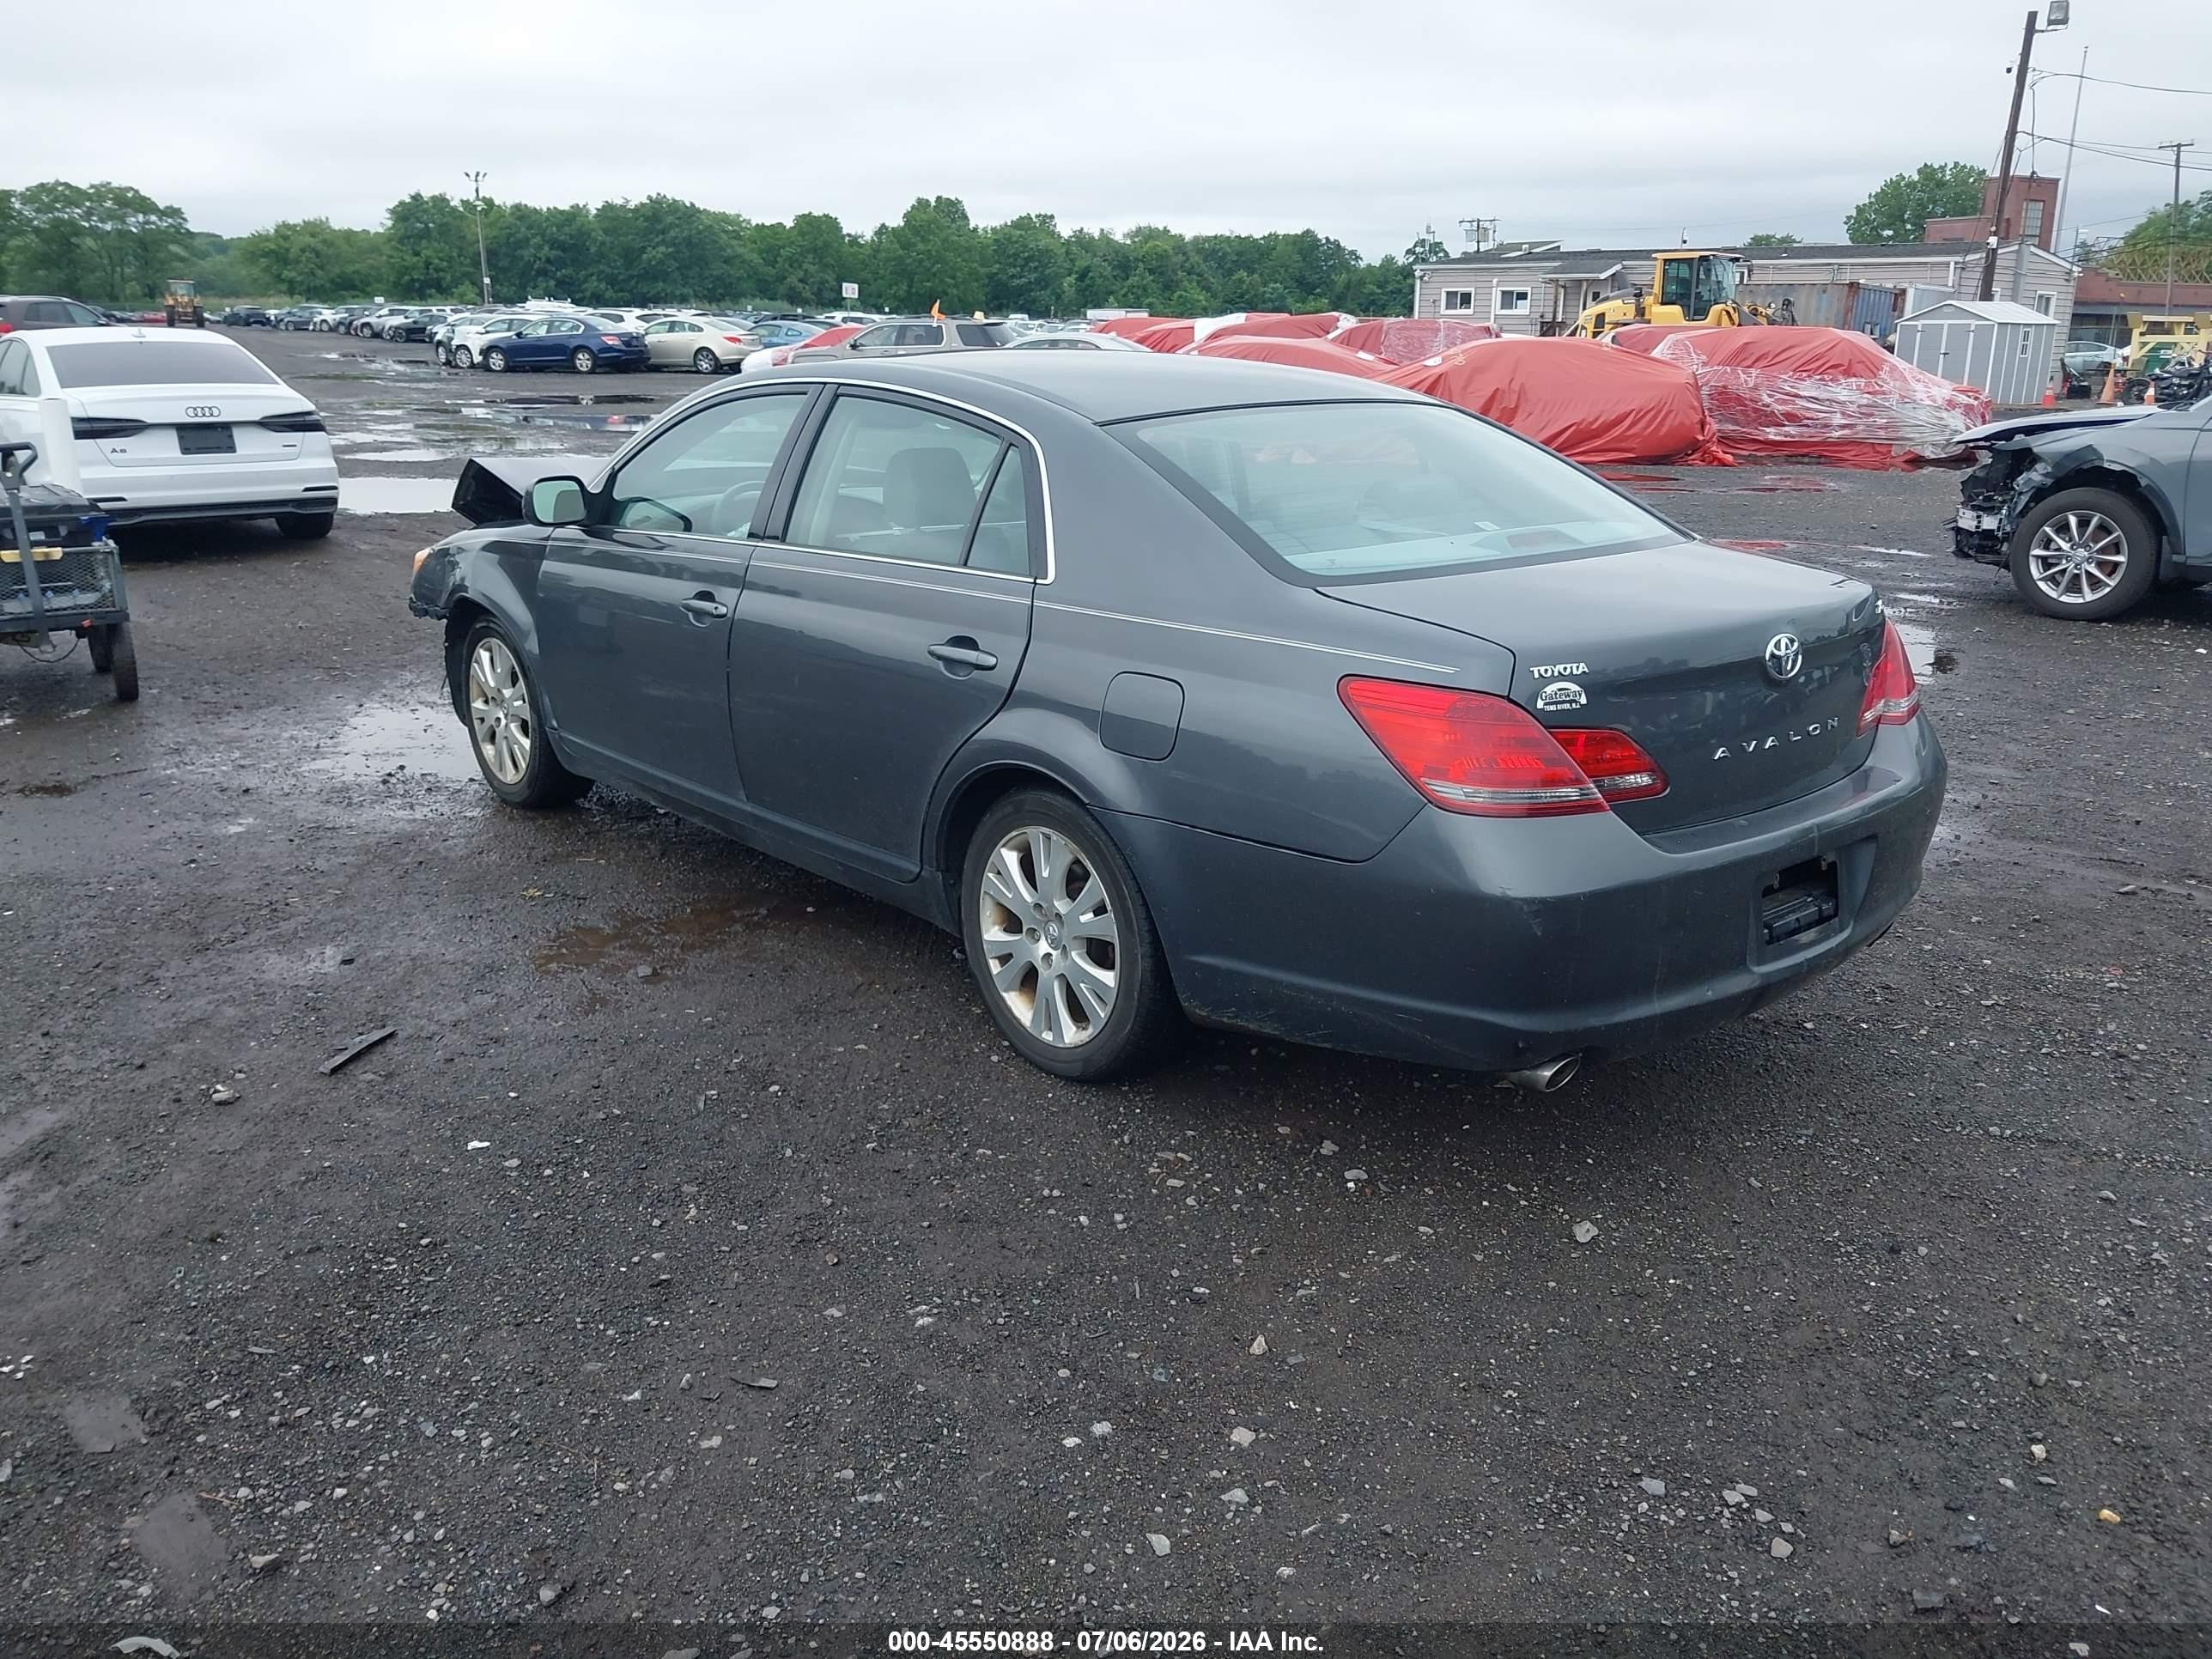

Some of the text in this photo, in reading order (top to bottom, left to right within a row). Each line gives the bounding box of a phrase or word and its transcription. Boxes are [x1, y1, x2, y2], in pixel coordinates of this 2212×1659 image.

[1529, 662, 1589, 679] TOYOTA
[1540, 690, 1583, 702] Gateway
[1712, 717, 1839, 761] AVALON
